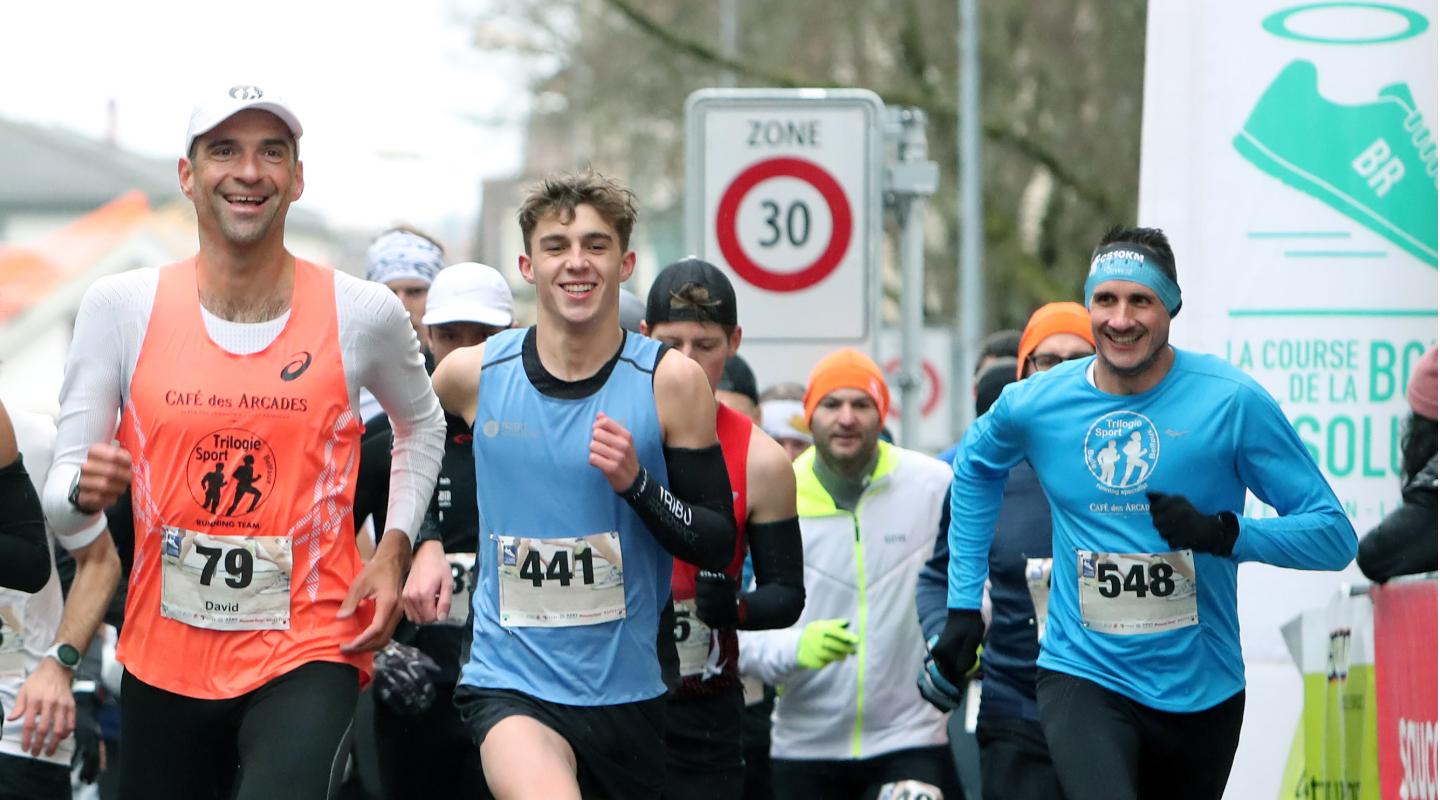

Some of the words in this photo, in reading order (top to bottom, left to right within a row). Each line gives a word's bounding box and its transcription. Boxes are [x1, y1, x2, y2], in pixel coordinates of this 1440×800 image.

[747, 119, 822, 147] ZONE
[1352, 138, 1406, 198] BR
[759, 199, 811, 247] 30
[1226, 339, 1253, 368] LA
[1262, 339, 1360, 369] COURSE
[165, 389, 203, 406] CAFÉ
[208, 394, 233, 408] des
[238, 393, 308, 412] ARCADES
[1289, 373, 1320, 403] DE
[1329, 373, 1357, 403] LA
[1095, 428, 1122, 438] Sport
[1106, 419, 1142, 430] Trilogie
[196, 448, 228, 463] Sport
[213, 434, 262, 452] Trilogie
[1125, 503, 1150, 512] ARCAD
[238, 520, 260, 529] TEAM
[195, 545, 254, 589] 79
[520, 547, 595, 587] 441
[1098, 563, 1175, 598] 548
[205, 600, 239, 612] David
